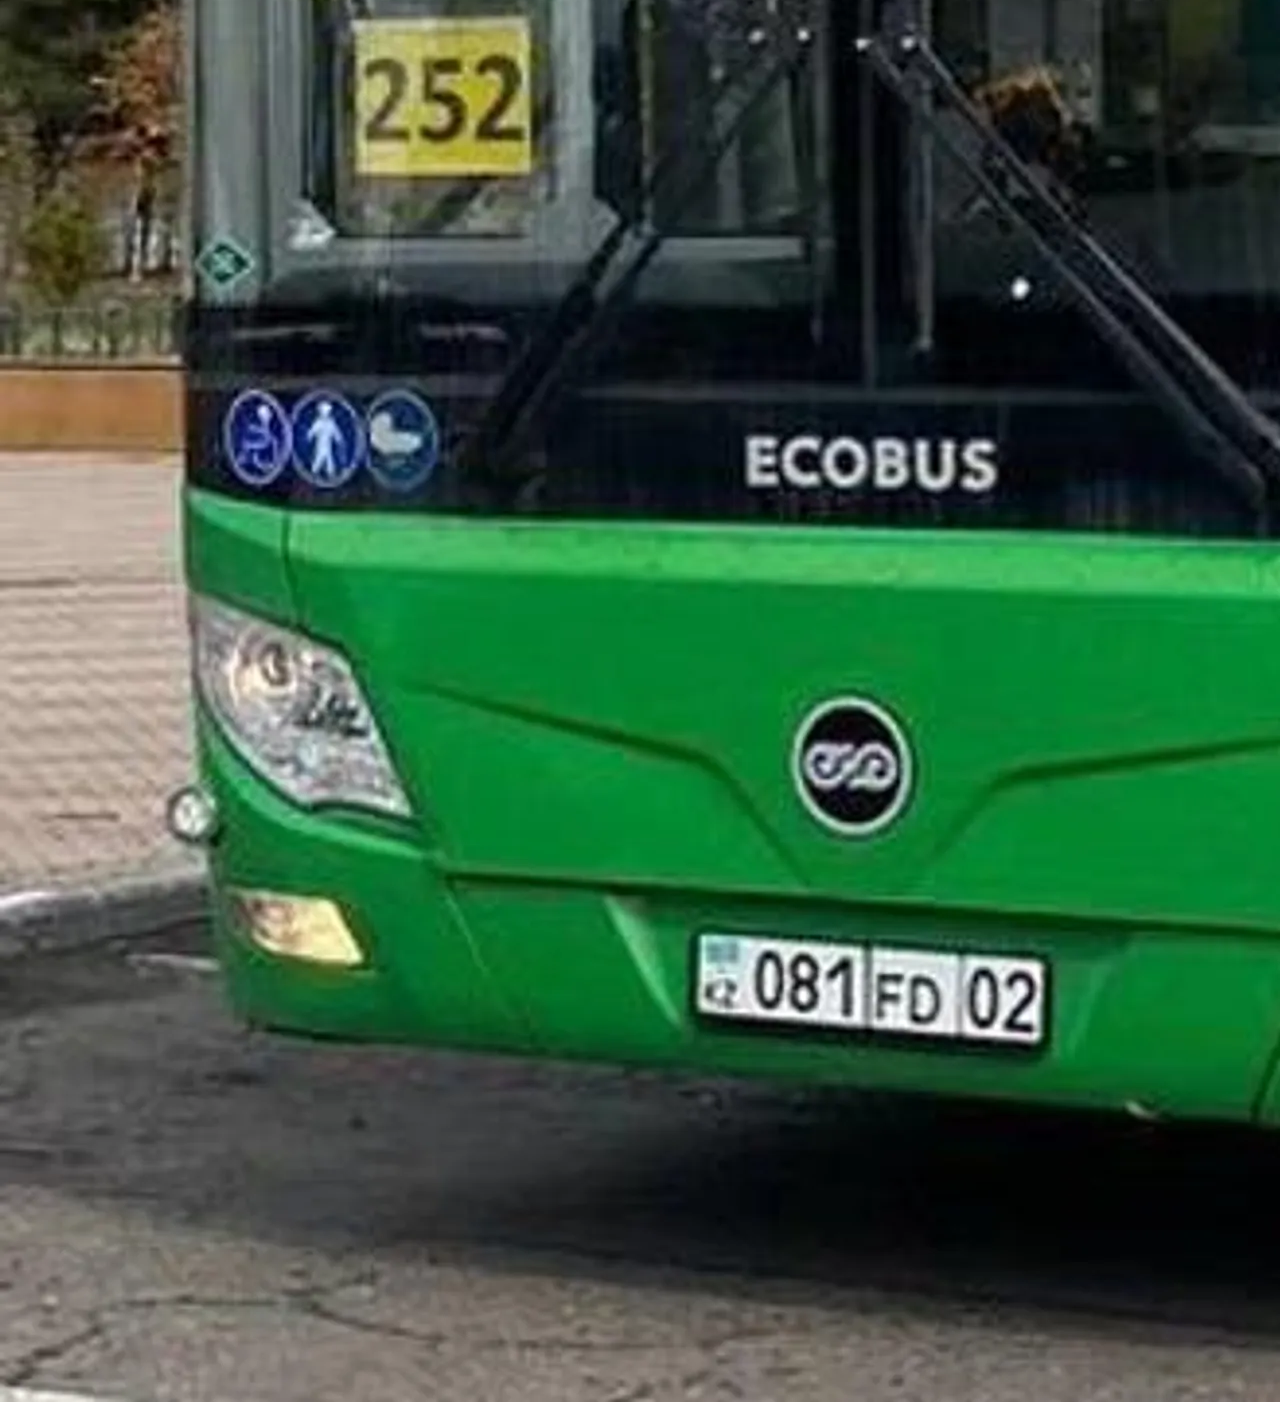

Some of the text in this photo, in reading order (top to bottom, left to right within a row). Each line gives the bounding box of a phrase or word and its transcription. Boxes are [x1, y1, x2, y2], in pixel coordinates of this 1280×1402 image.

[366, 54, 525, 142] 252
[745, 435, 997, 492] ECOBUS
[754, 949, 853, 1019] 081
[875, 973, 941, 1025] FD
[968, 968, 1037, 1034] 02
